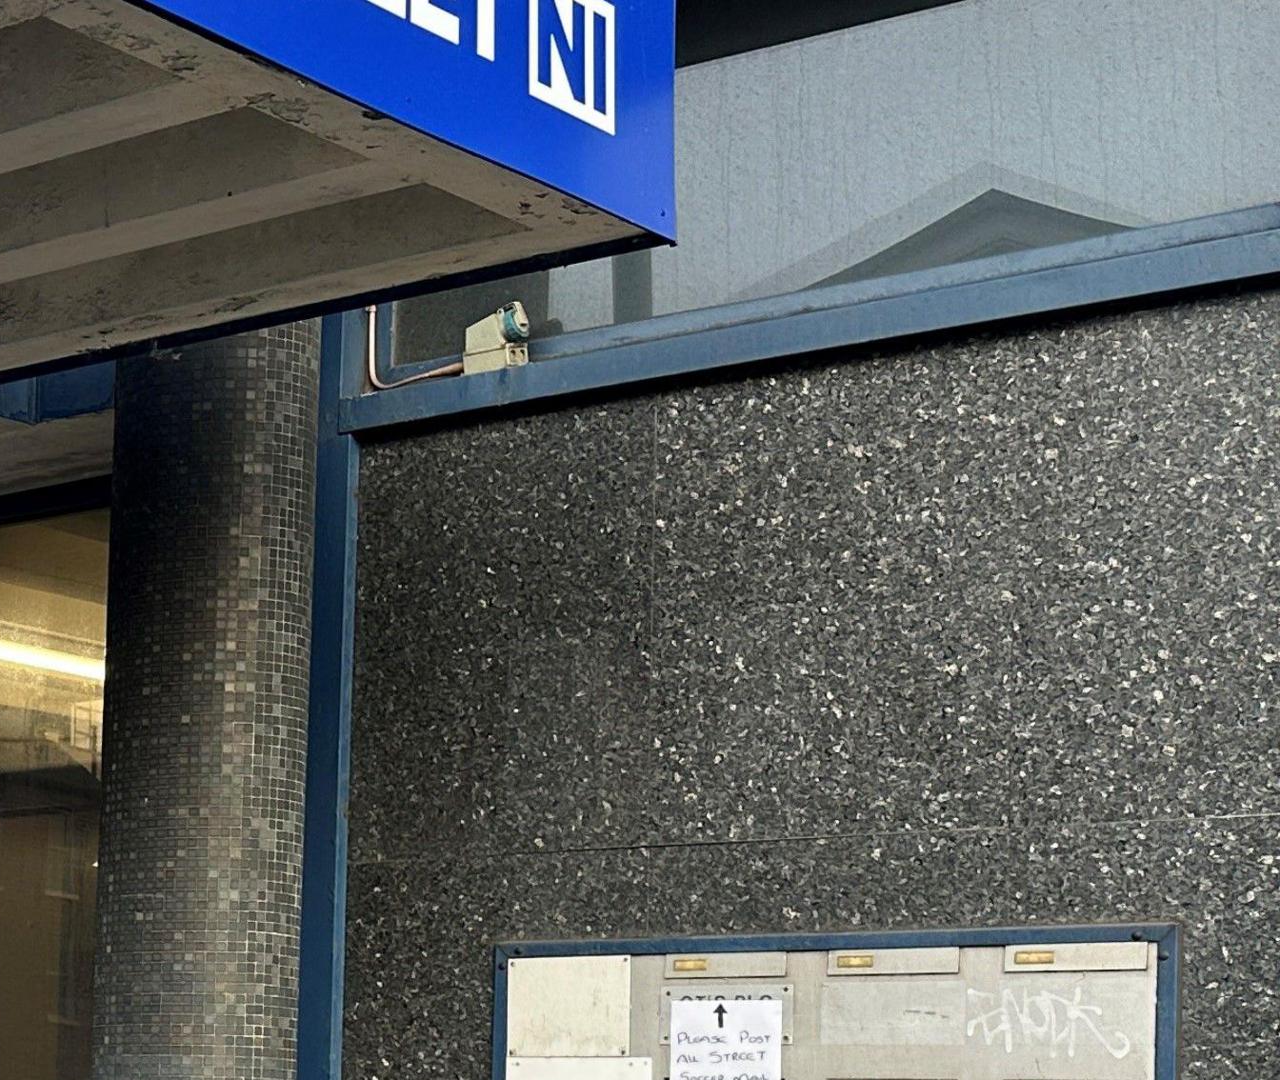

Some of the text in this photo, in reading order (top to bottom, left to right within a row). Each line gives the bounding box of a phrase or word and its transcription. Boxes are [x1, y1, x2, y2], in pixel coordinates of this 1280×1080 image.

[676, 1030, 772, 1045] PLEASE POST
[676, 1050, 766, 1064] ALL STREET
